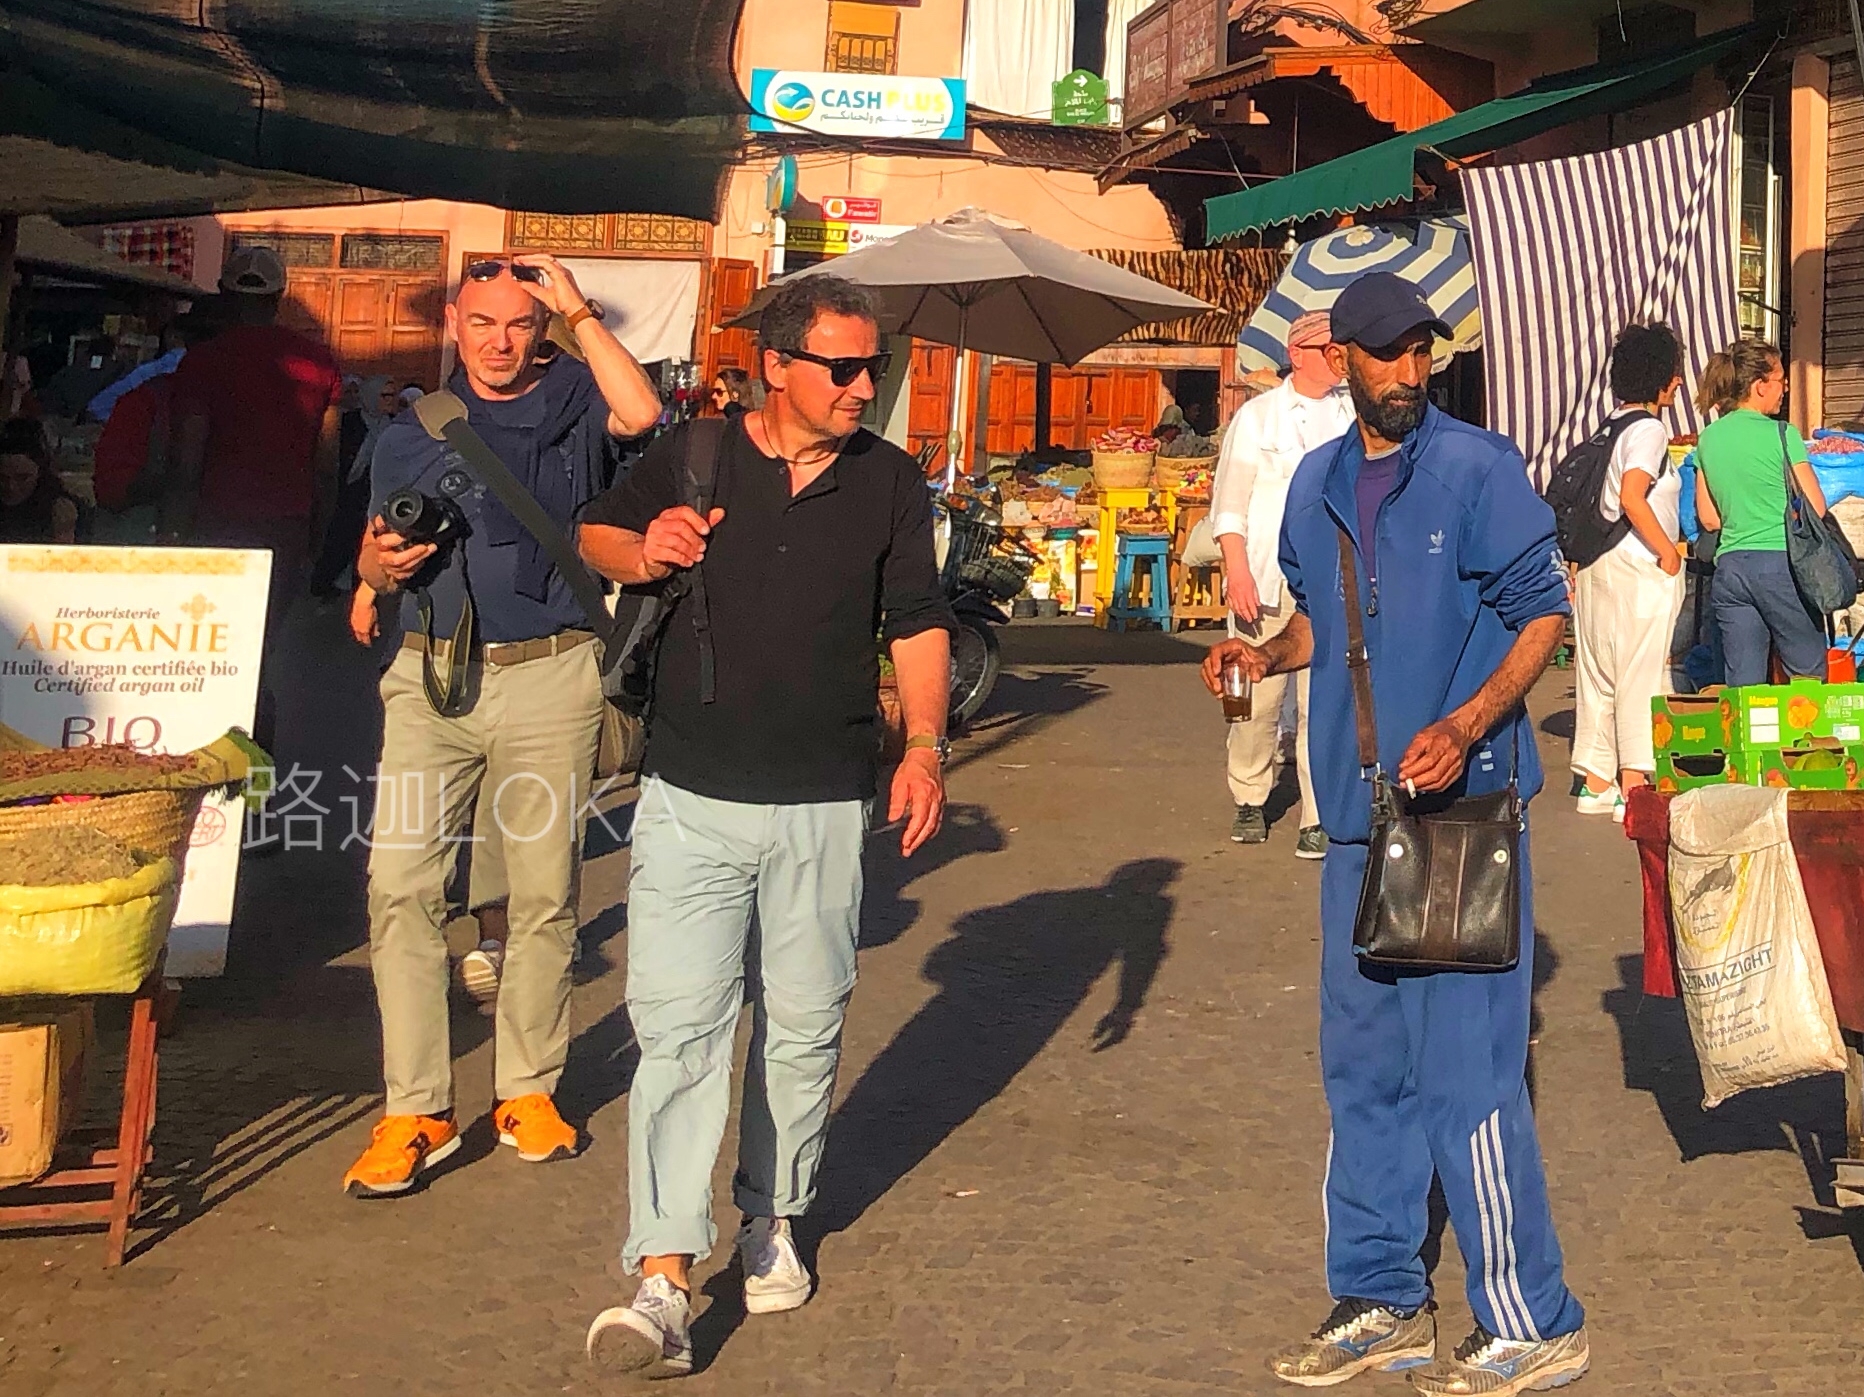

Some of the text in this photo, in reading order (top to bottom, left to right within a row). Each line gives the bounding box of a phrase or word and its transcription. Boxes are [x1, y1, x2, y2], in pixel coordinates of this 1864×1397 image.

[821, 88, 946, 113] CASH PLUS
[56, 606, 160, 620] Herboristerie
[16, 621, 230, 652] ARGANIE
[2, 659, 239, 679] Huile d'argan certifiée bio
[34, 677, 204, 696] Certified argan oil
[62, 716, 162, 750] BIO
